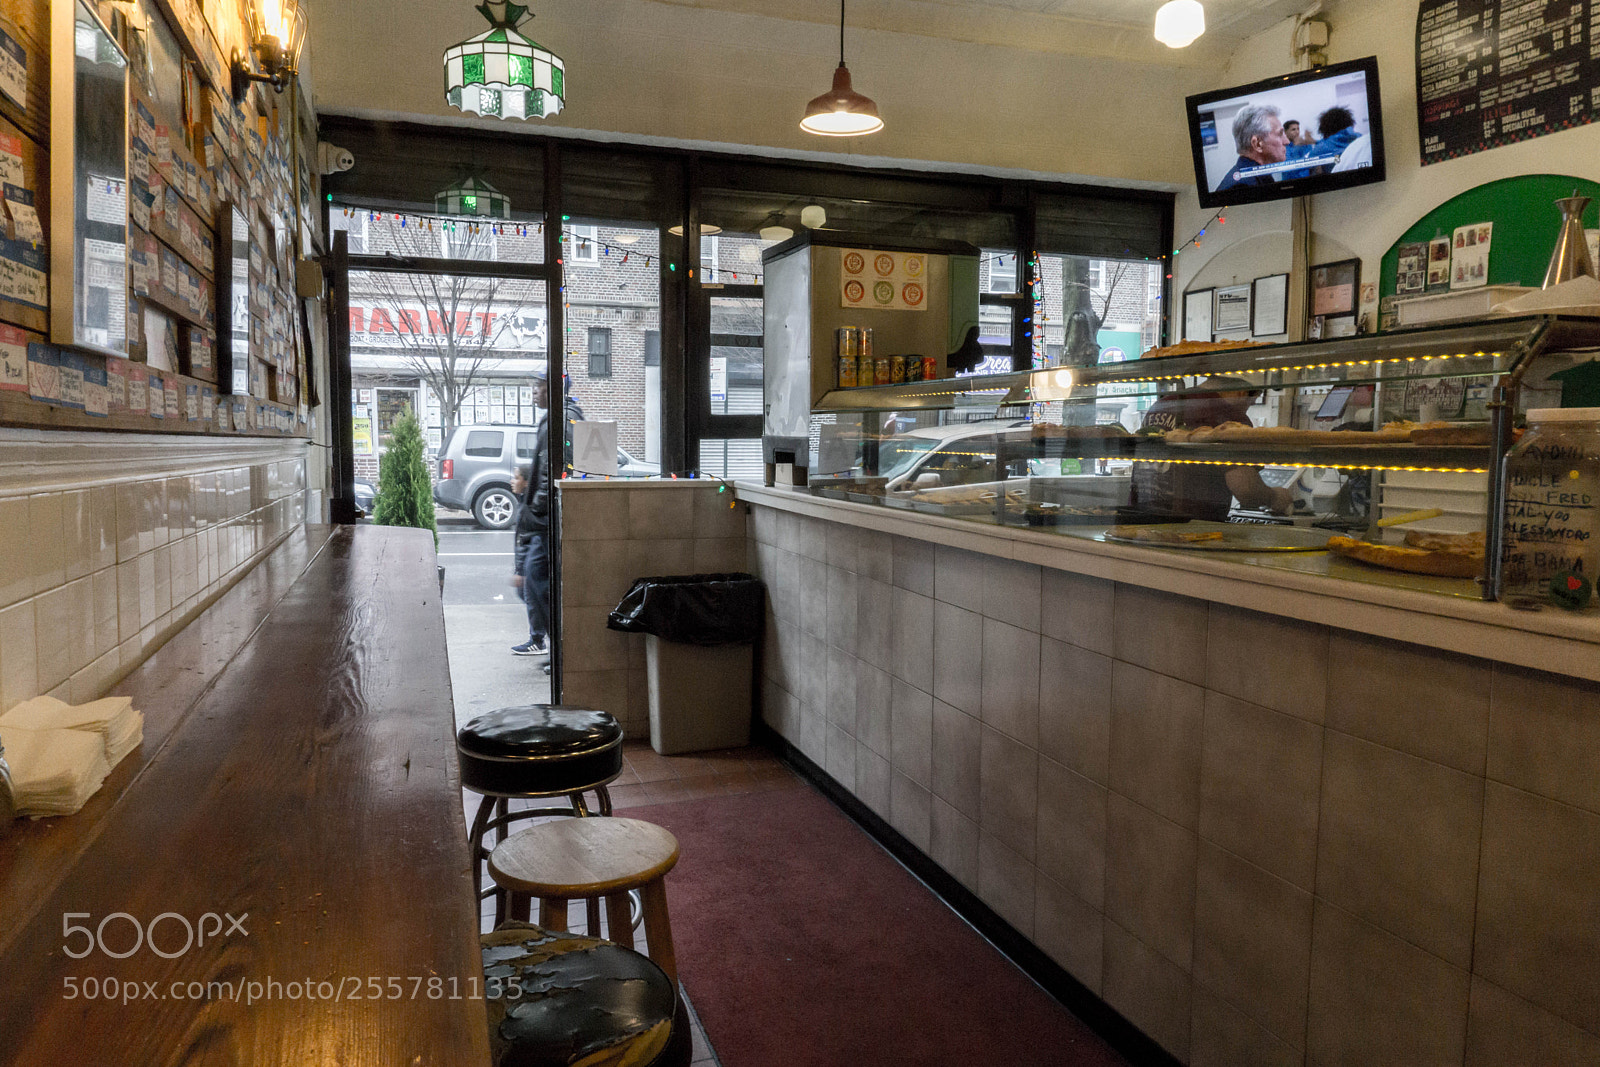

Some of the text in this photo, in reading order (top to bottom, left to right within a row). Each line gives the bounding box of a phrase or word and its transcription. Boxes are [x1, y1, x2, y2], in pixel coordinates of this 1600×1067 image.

[1502, 119, 1531, 133] SPECIALTY
[1547, 491, 1591, 504] FRED
[1503, 520, 1590, 541] ALESSANDRO
